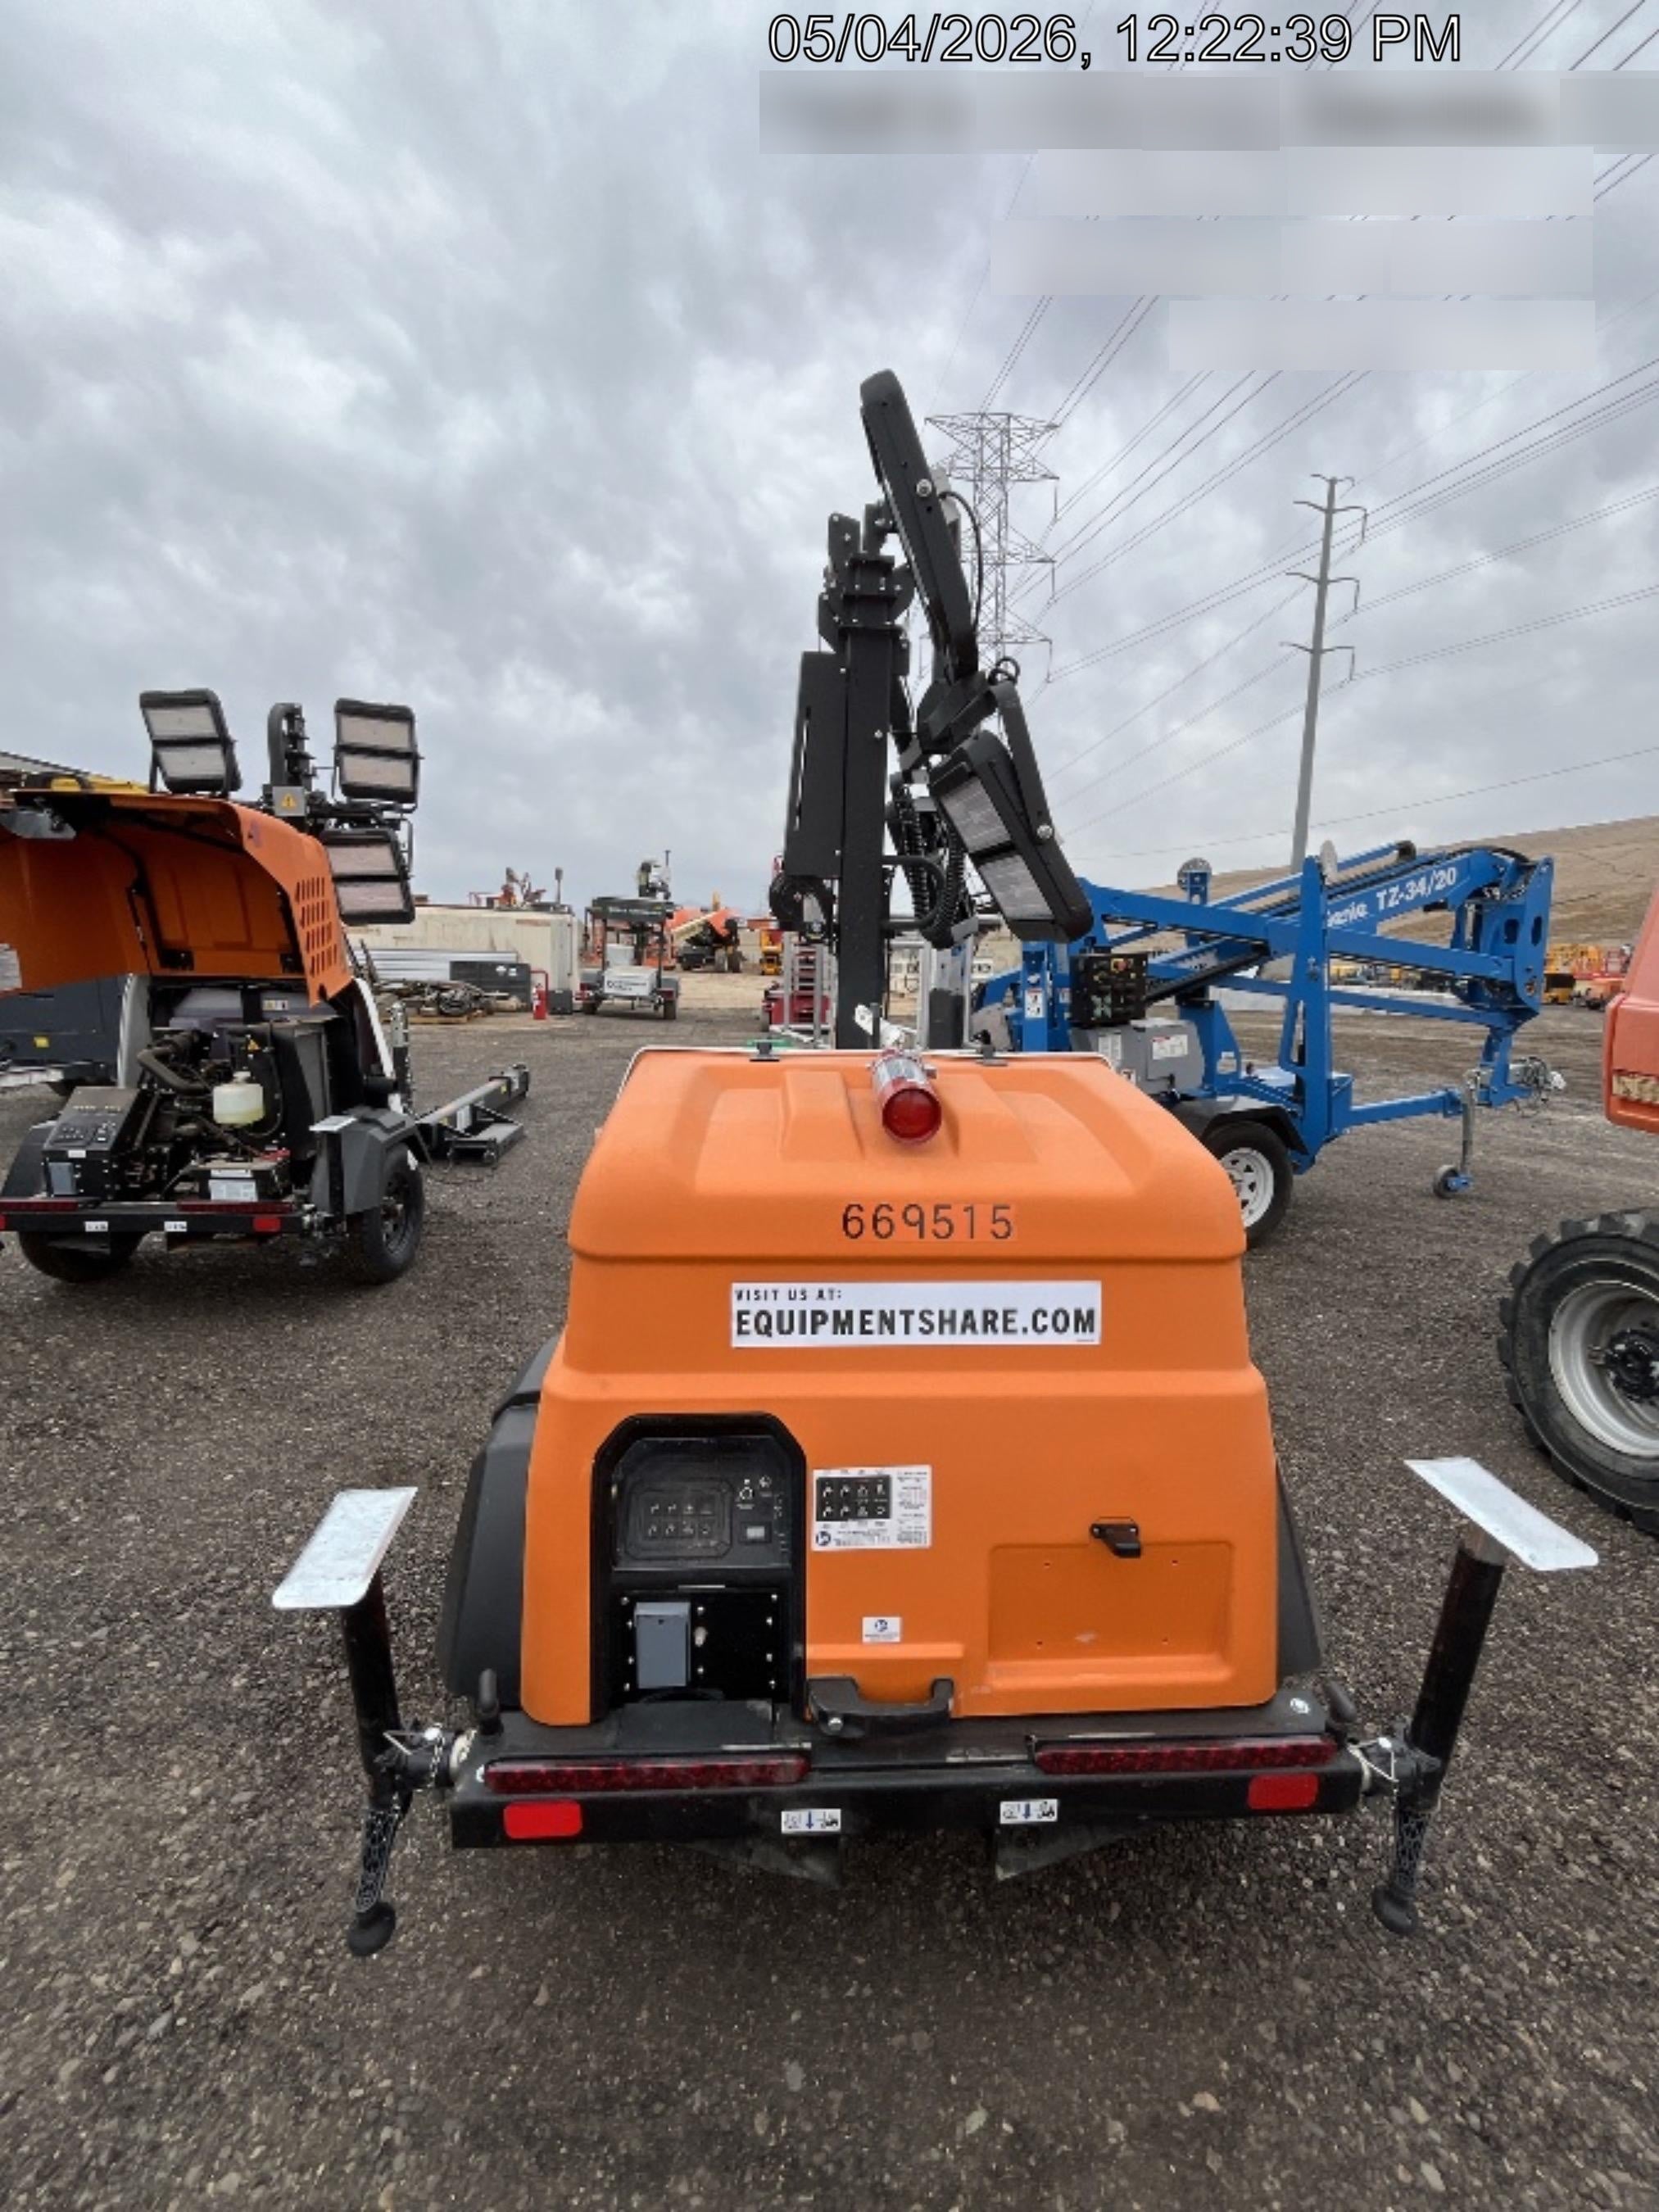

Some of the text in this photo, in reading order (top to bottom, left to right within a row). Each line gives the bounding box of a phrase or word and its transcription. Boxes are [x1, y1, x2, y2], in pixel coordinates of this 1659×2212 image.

[1376, 867, 1457, 912] TZ-34/20
[841, 1203, 1013, 1240] 669515
[735, 1289, 841, 1301] VISIT US AT:
[736, 1308, 1096, 1337] EQUIPMENTSHARE.COM
